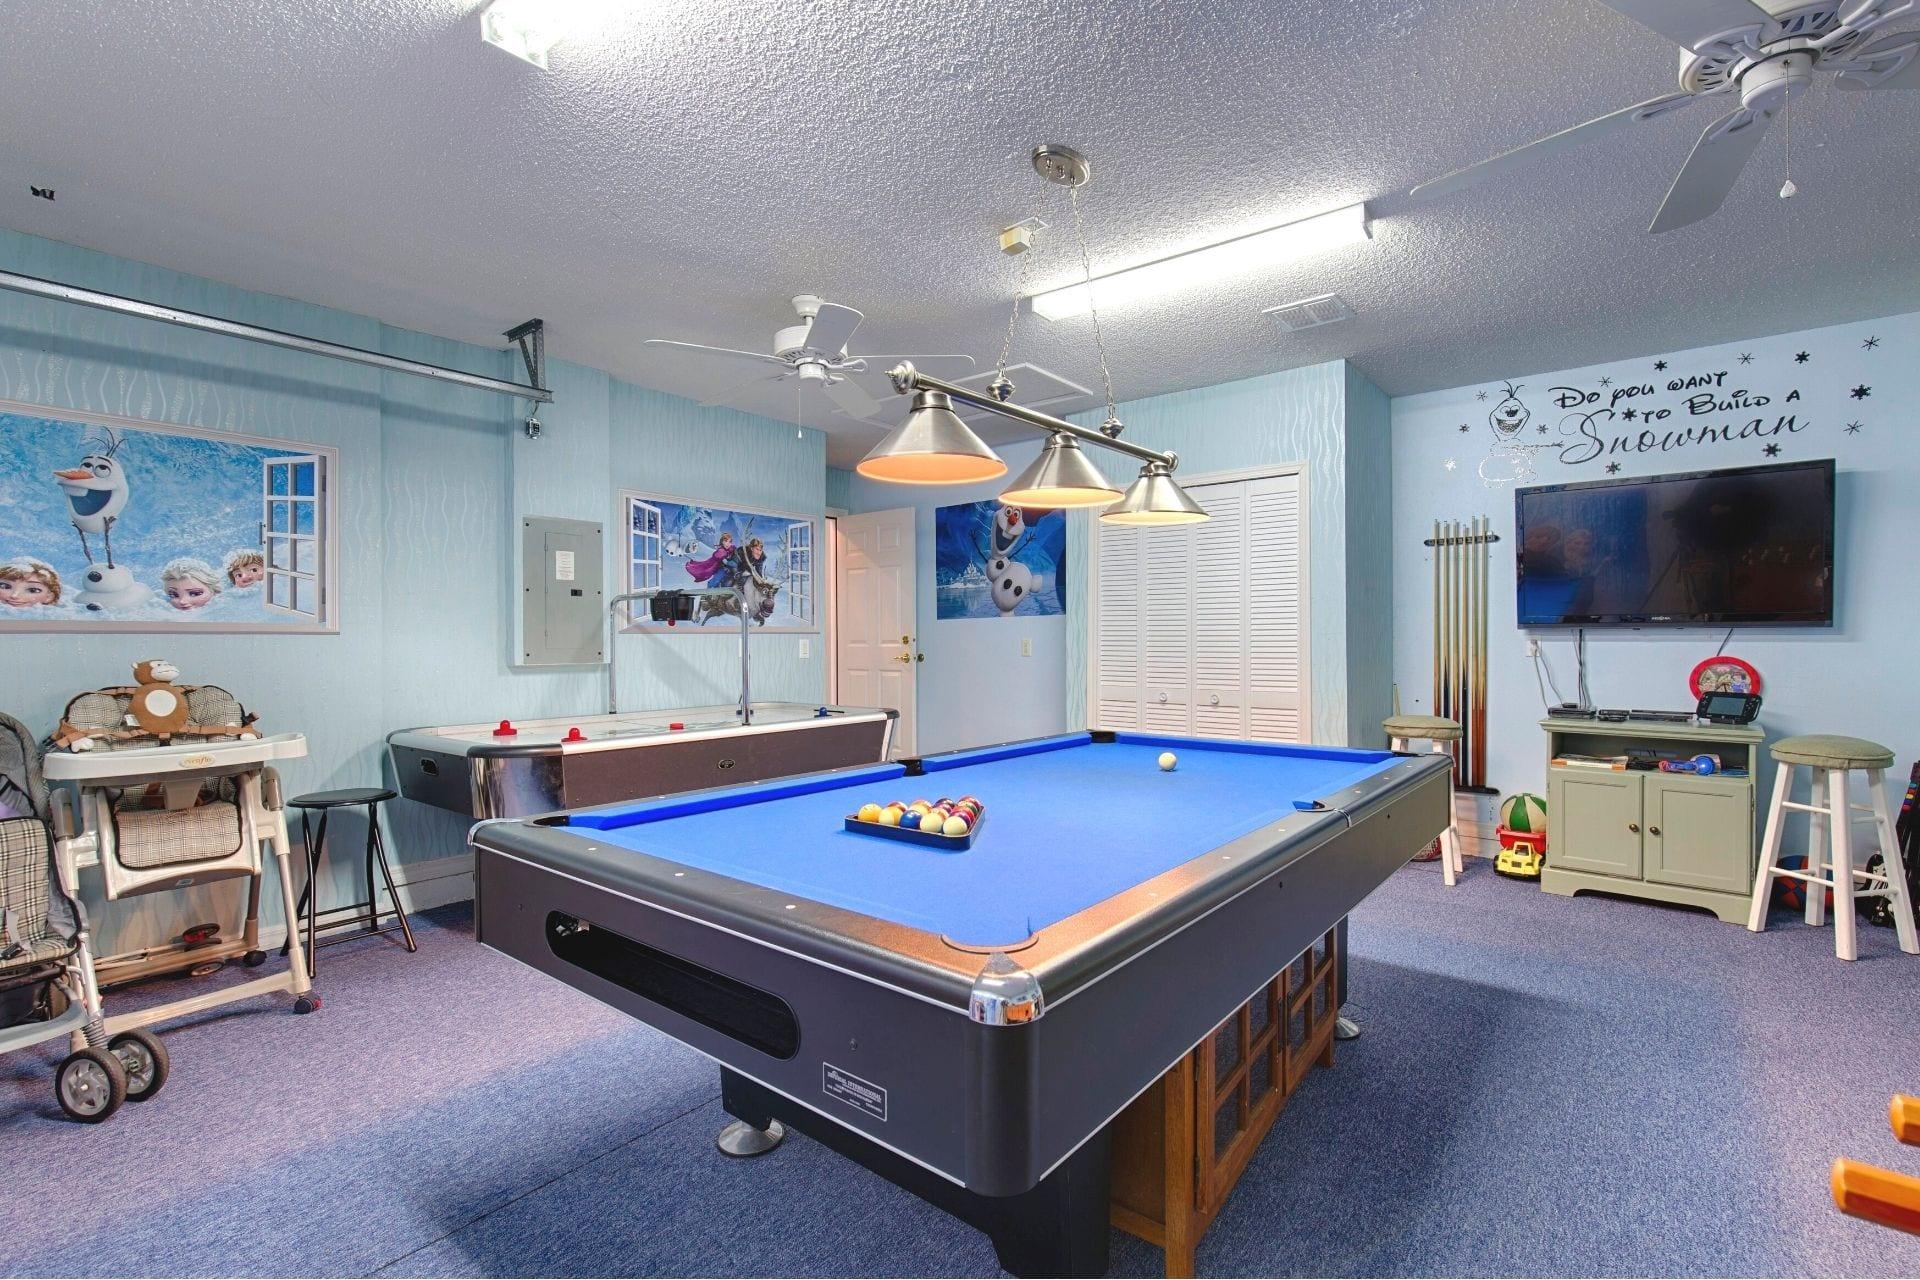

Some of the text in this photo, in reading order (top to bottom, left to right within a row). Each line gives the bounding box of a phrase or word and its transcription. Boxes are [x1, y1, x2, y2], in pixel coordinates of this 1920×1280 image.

[1548, 386, 1601, 409] Do
[1610, 384, 1655, 409] you
[1558, 408, 1810, 465] Snowman
